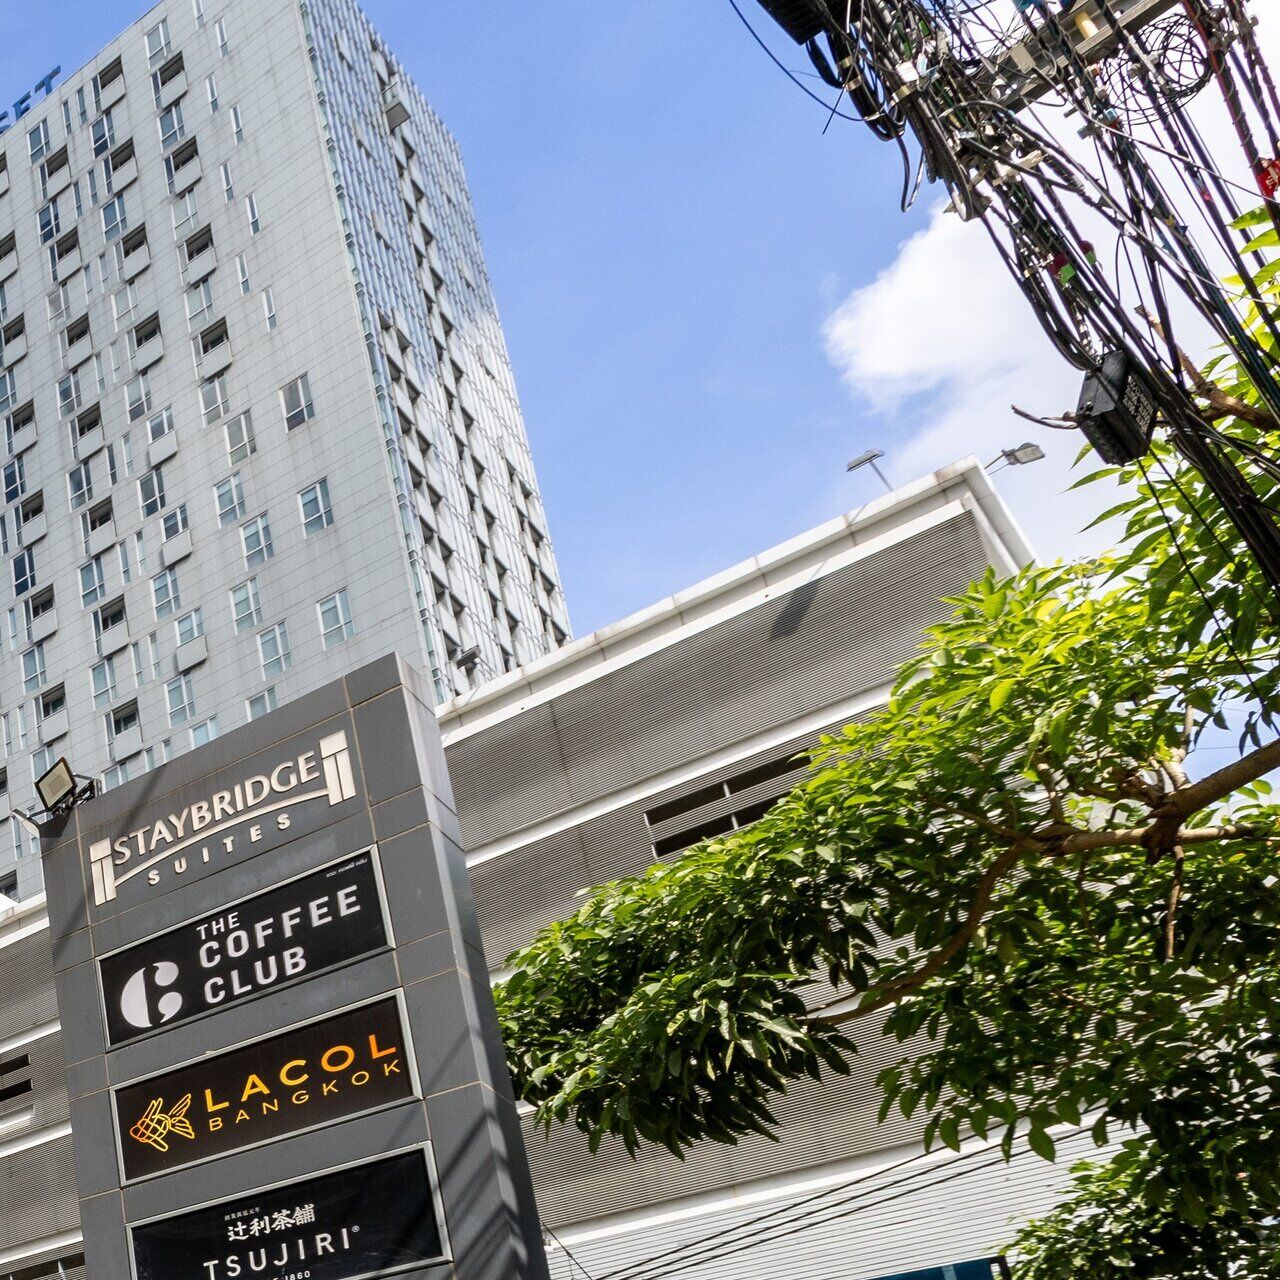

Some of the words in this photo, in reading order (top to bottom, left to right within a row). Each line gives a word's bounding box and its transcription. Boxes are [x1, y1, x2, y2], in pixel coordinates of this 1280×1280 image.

[112, 750, 321, 867] STAYBRIDGE
[147, 814, 291, 886] SUITES
[196, 911, 241, 941] THE
[198, 884, 363, 970] COFFEE
[203, 945, 308, 1005] CLUB
[204, 1034, 397, 1113] LACOL
[209, 1059, 401, 1132] BANGKOK
